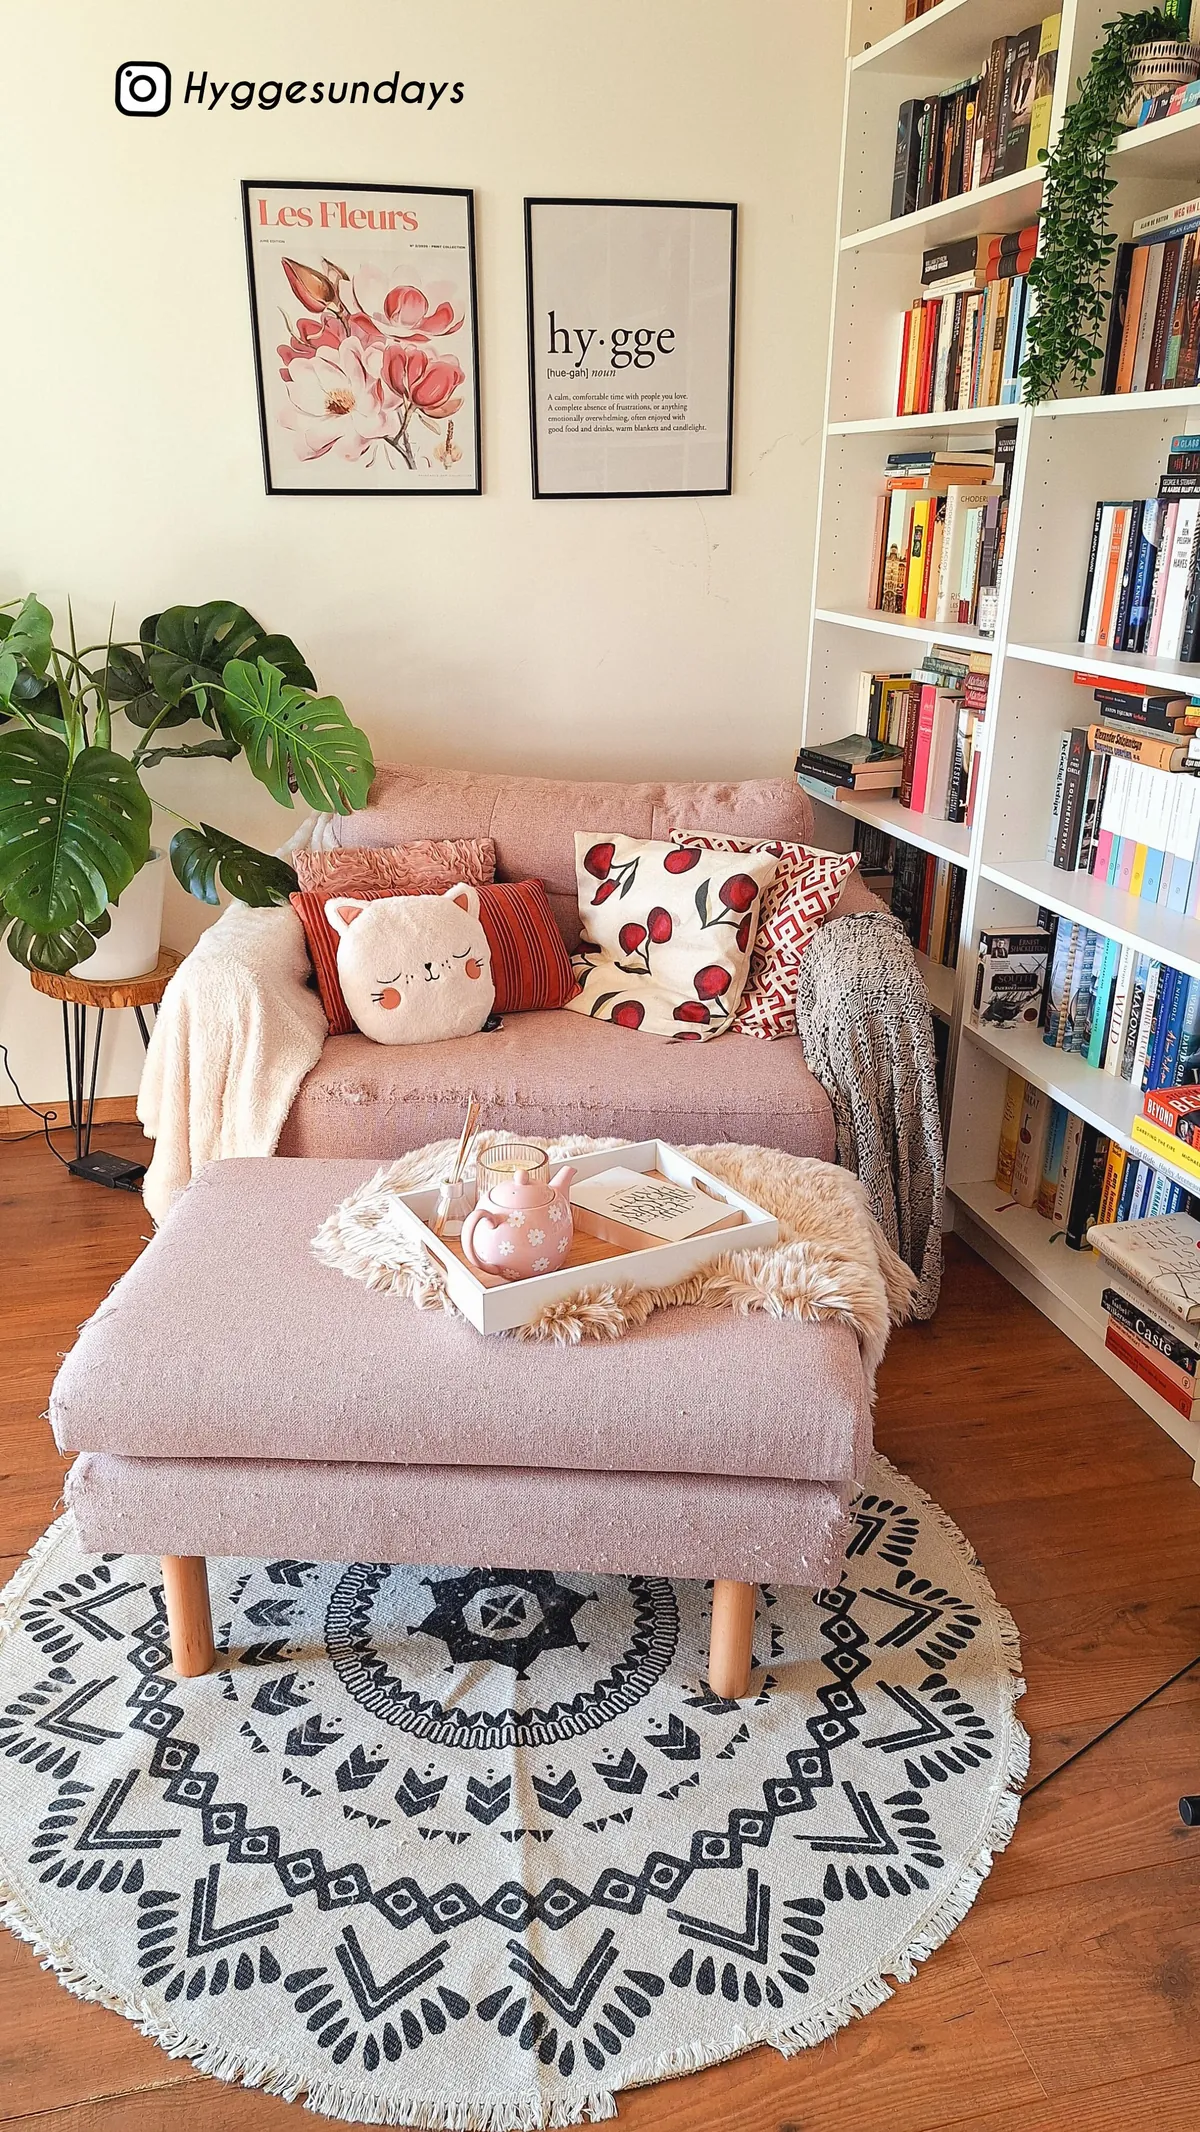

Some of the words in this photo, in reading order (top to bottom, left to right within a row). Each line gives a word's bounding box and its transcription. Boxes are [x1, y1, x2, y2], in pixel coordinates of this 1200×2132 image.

[258, 199, 313, 228] Les
[319, 201, 419, 231] Fleurs
[1173, 207, 1185, 219] WEG
[1187, 203, 1196, 214] VAN
[1164, 273, 1172, 304] KUNDERA
[1161, 309, 1166, 317] DE
[547, 310, 676, 369] hy·gge
[1155, 318, 1164, 367] ONDRAAGLIJKE
[547, 368, 589, 379] [hue-gah]
[591, 369, 616, 377] noun
[640, 393, 660, 402] people
[554, 404, 582, 412] complete
[661, 403, 687, 411] anything
[548, 415, 584, 423] emotionally
[585, 414, 629, 422] overwhelming,
[648, 414, 671, 422] enjoyed
[548, 425, 564, 434] good
[673, 424, 707, 432] candlelight.
[1180, 439, 1200, 448] GLASS
[945, 537, 950, 545] DE
[1140, 562, 1145, 570] AS
[1173, 559, 1188, 568] HAYES
[1138, 572, 1143, 582] WE
[1094, 728, 1116, 744] Alexander
[1062, 739, 1068, 750] De
[1057, 752, 1066, 781] Goelag
[1067, 767, 1080, 775] CIRCLE
[1053, 781, 1062, 816] Archipel
[1061, 782, 1075, 850] SOLZHENITSYN
[998, 974, 1032, 982] SOUTH
[1144, 994, 1155, 1027] BARRE
[1170, 987, 1183, 1021] NICHOLS
[1186, 994, 1195, 1025] WAGER
[1110, 994, 1125, 1044] WILD
[1127, 979, 1145, 1048] AMAZONE
[1137, 1028, 1149, 1063] VLUCHT
[1180, 1035, 1190, 1062] DAVID
[1147, 1098, 1174, 1128] BEYOND
[1136, 1126, 1157, 1141] CARRYING
[1158, 1139, 1166, 1147] THE
[1166, 1143, 1176, 1152] FIRE
[1130, 1145, 1142, 1158] Wild
[1142, 1153, 1156, 1165] Ride
[1158, 1163, 1175, 1178] Hayley
[1134, 1175, 1142, 1198] CLIMB
[1155, 1176, 1164, 1190] JON
[1099, 1164, 1113, 1224] meidenroman
[1106, 1191, 1116, 1223] keuken
[1141, 1217, 1176, 1227] CARLIN
[1137, 1226, 1181, 1239] THE
[1146, 1236, 1194, 1250] END
[1173, 1249, 1195, 1258] IS
[1146, 1308, 1157, 1317] INTO
[1136, 1319, 1172, 1356] Caste
